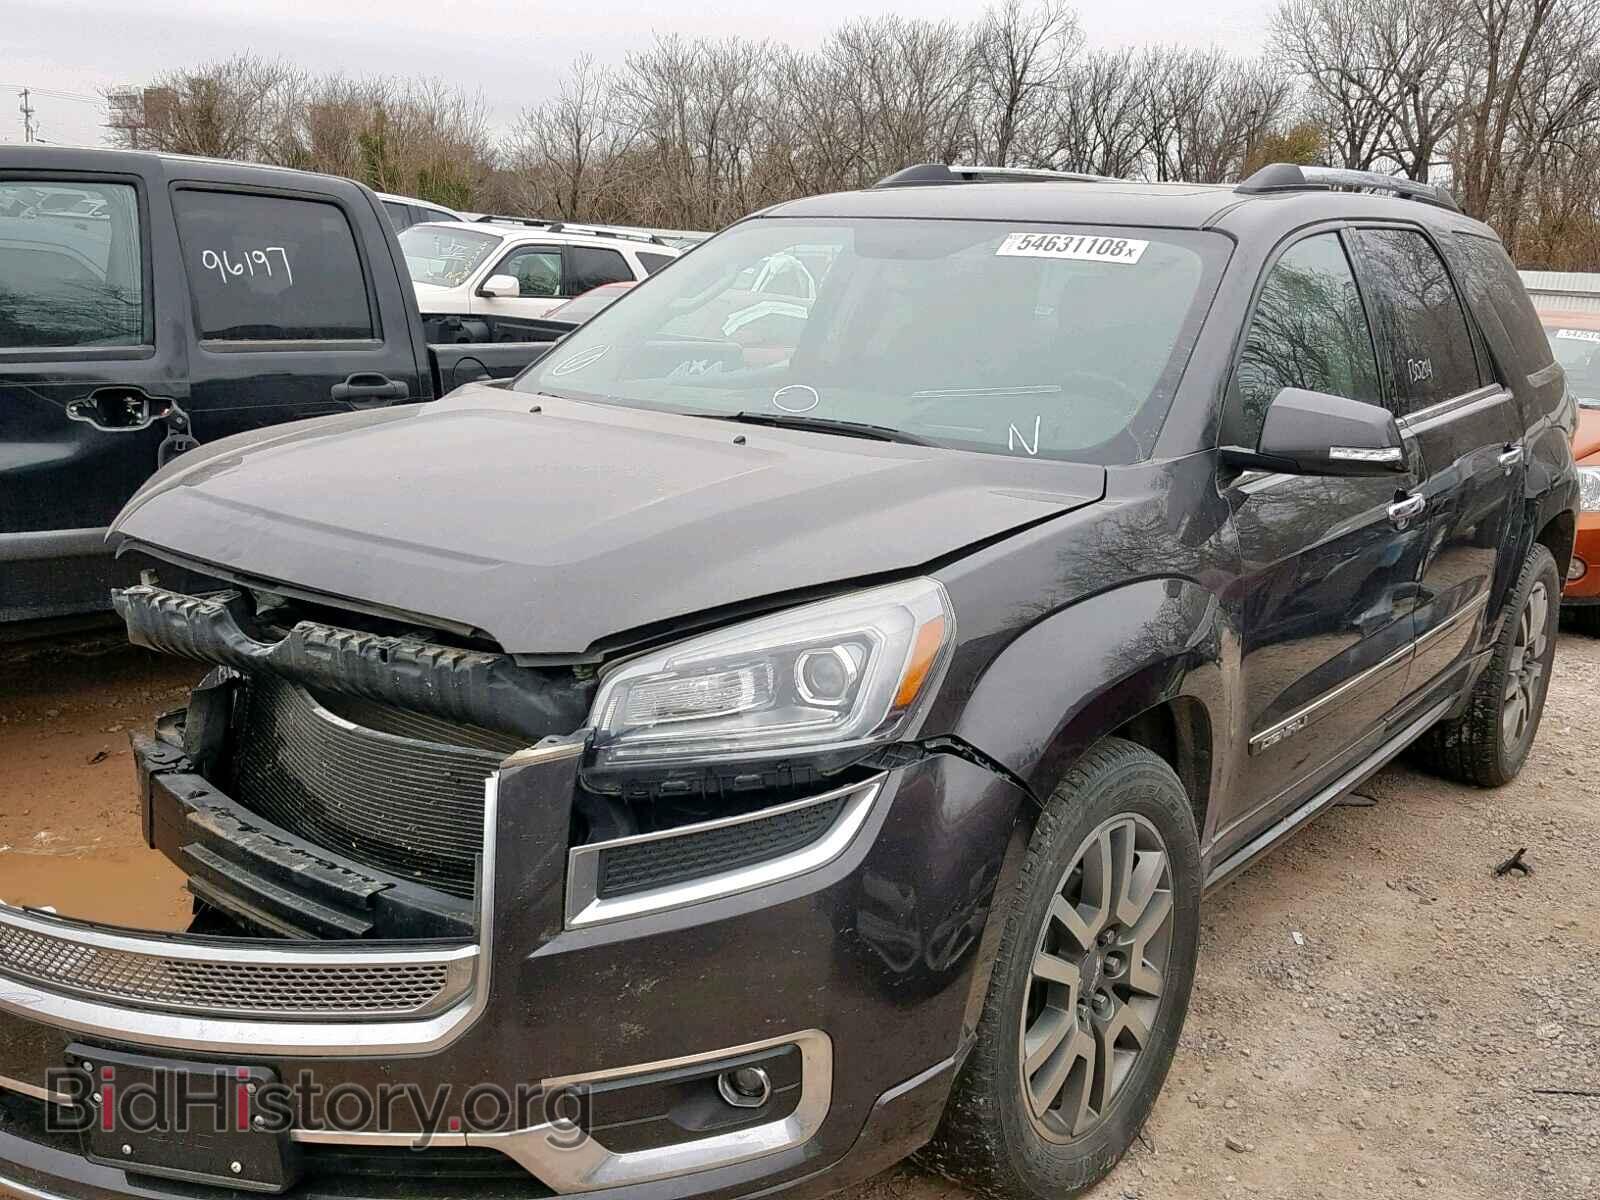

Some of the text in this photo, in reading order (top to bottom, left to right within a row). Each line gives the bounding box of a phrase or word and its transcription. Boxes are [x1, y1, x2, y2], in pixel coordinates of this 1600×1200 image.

[202, 247, 293, 286] 96197
[1008, 415, 1041, 455] N
[1261, 715, 1309, 750] DENALI
